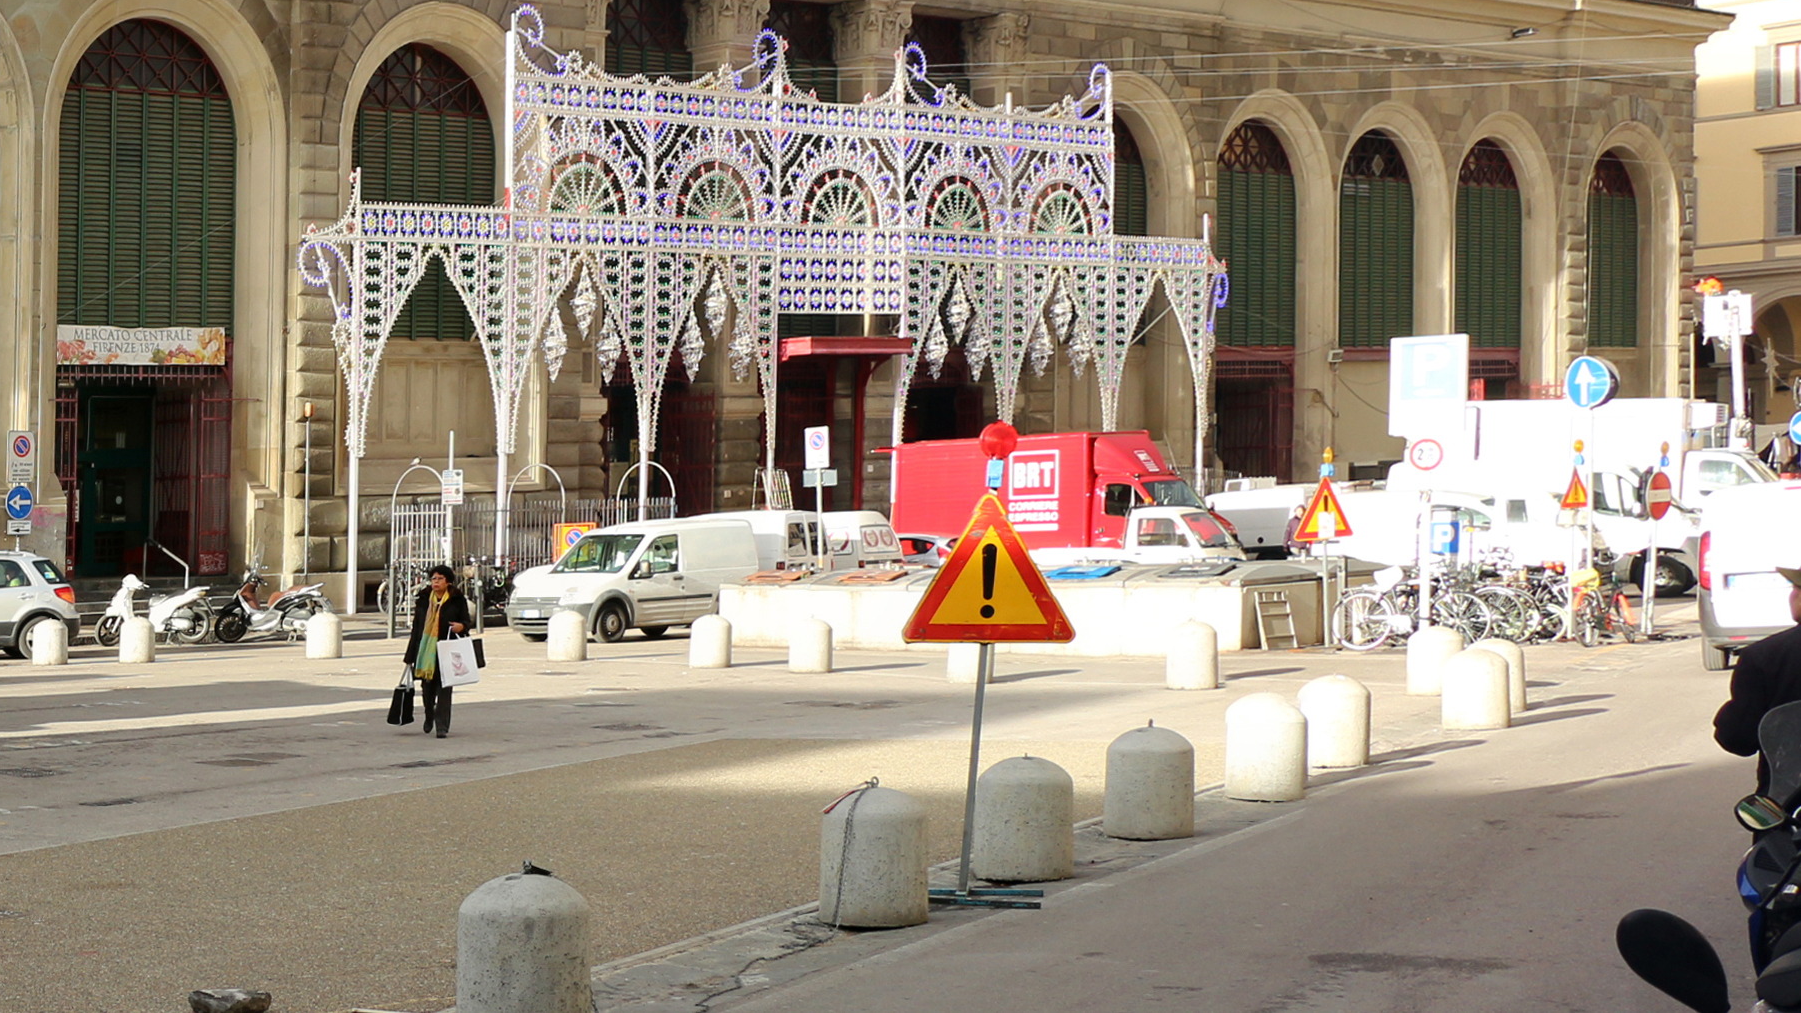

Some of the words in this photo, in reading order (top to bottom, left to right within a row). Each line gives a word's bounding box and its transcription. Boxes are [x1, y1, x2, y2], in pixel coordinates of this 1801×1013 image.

[74, 328, 131, 341] MERCATO
[133, 328, 193, 341] CENTRALE
[93, 342, 136, 354] FIRENZE
[139, 343, 160, 354] 1874
[1413, 345, 1451, 387] P
[1013, 462, 1055, 489] BRT
[1009, 501, 1059, 512] CORRIERE
[1008, 512, 1059, 522] ESPRESSO
[1433, 524, 1456, 552] P
